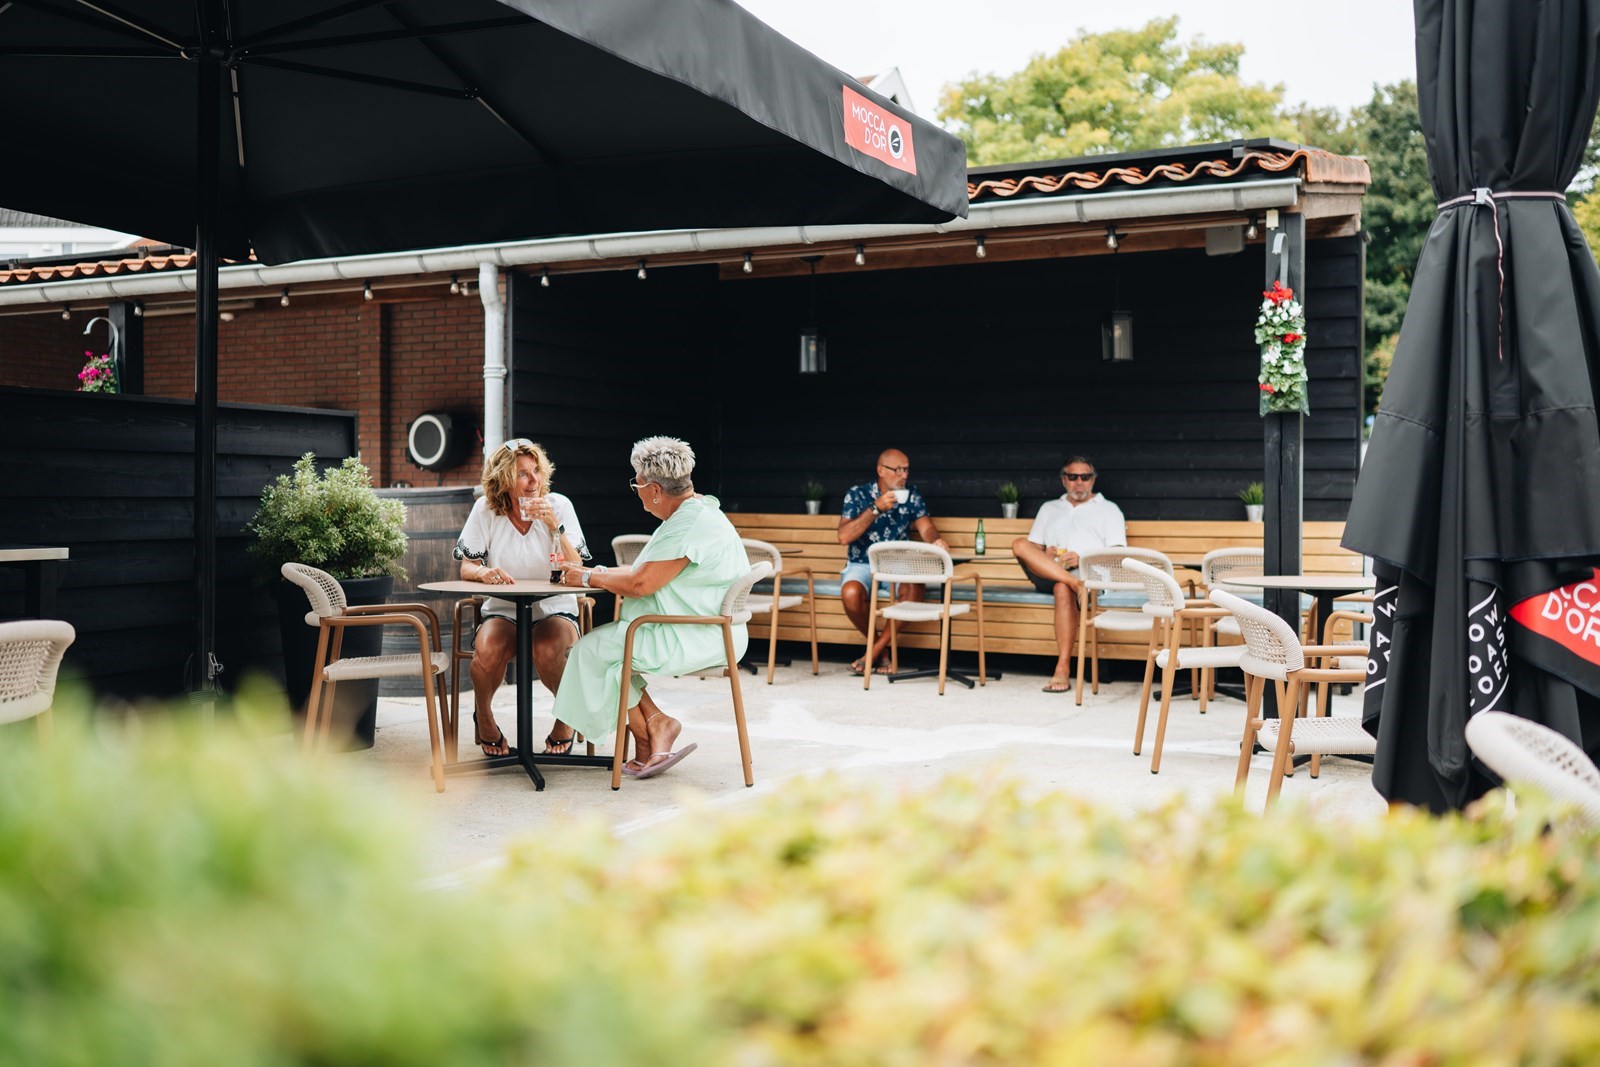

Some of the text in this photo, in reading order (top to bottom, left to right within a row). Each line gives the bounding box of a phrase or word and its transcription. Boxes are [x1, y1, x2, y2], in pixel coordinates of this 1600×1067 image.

[852, 101, 886, 134] MOCCA
[865, 127, 886, 152] D'OR
[1541, 591, 1600, 648] D'OR
